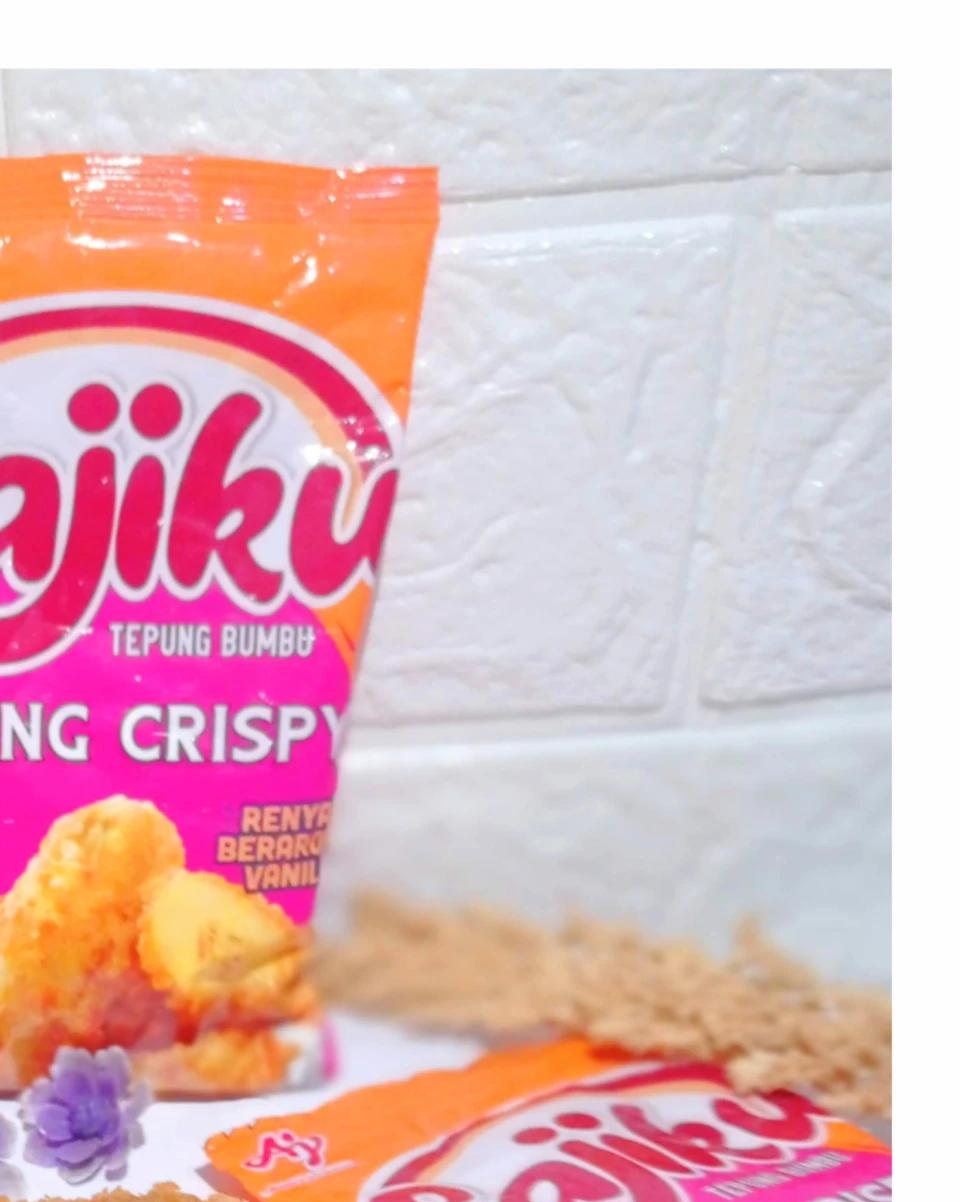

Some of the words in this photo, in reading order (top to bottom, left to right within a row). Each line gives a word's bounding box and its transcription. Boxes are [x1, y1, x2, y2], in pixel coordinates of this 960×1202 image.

[110, 622, 211, 657] TEPUNG
[221, 624, 315, 657] BUMBU
[121, 704, 341, 763] CRISPY
